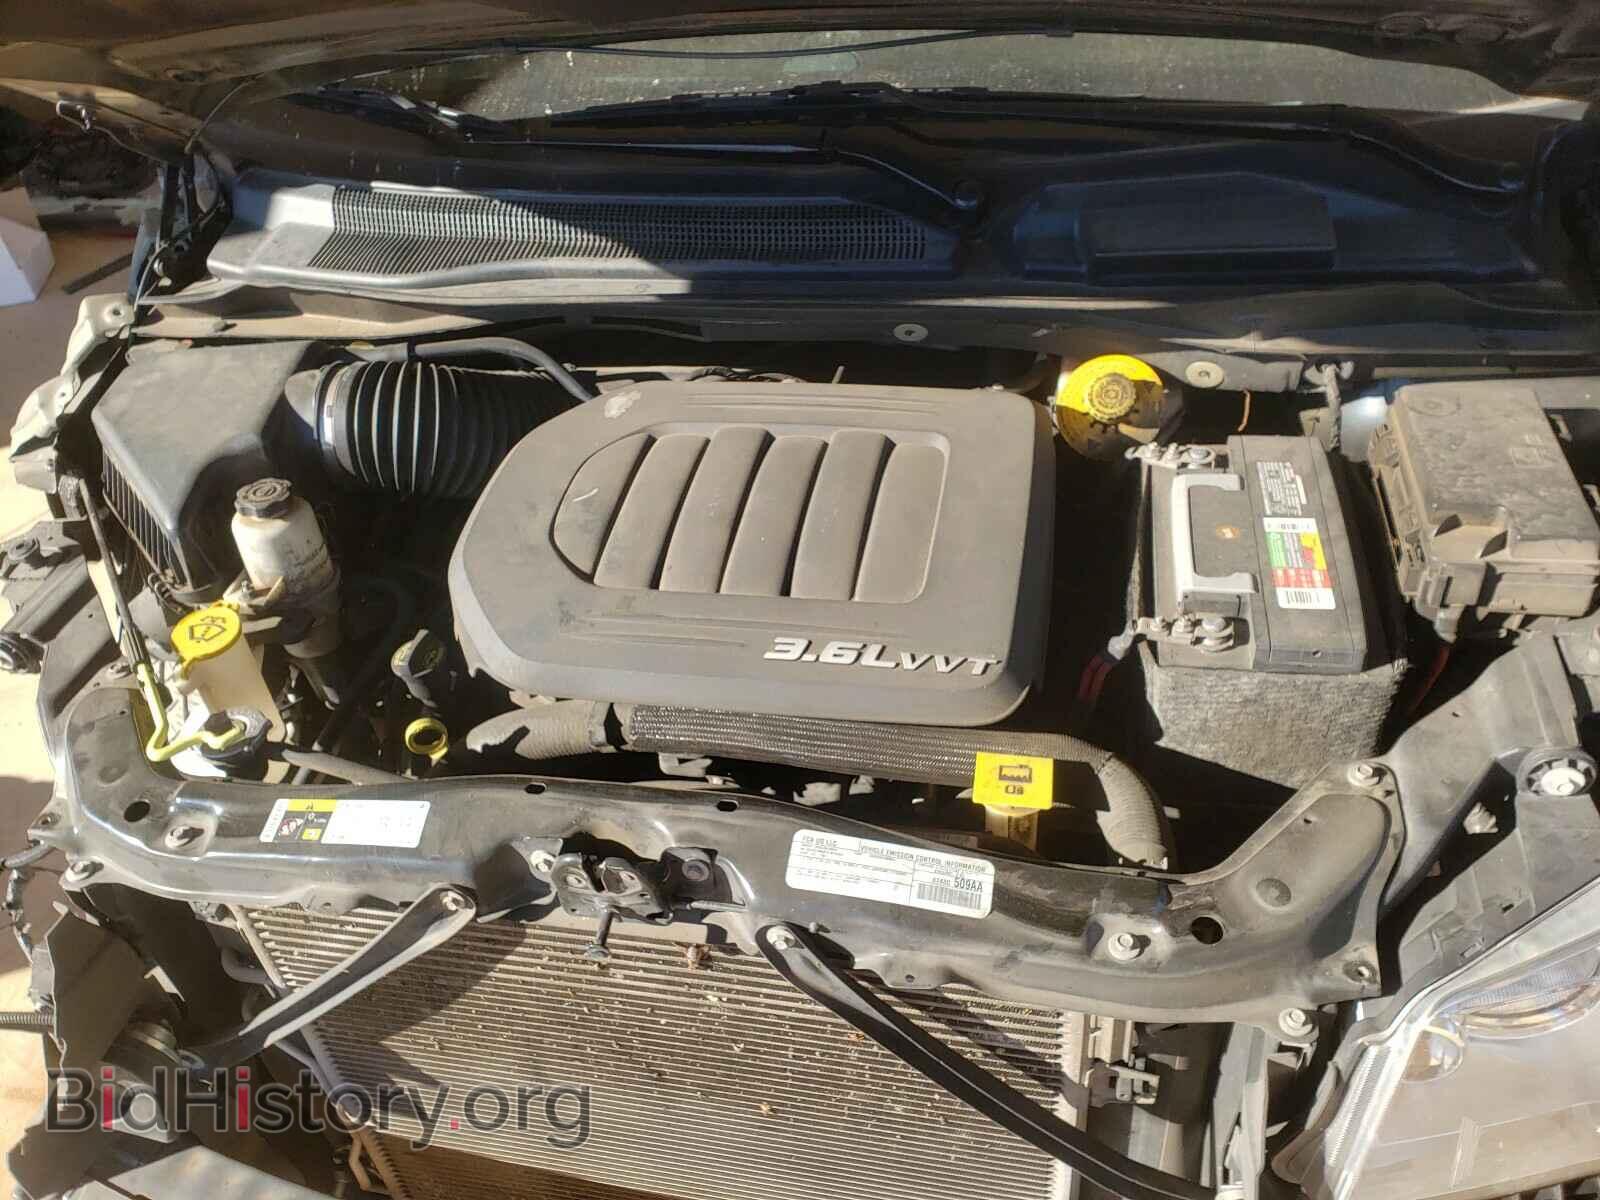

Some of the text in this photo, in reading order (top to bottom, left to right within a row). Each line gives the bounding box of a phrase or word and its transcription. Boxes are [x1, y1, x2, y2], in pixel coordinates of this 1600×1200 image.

[886, 848, 914, 859] EMISSION
[915, 855, 942, 865] CONTROL
[944, 860, 987, 872] INFORMATION
[953, 876, 983, 893] 509AA
